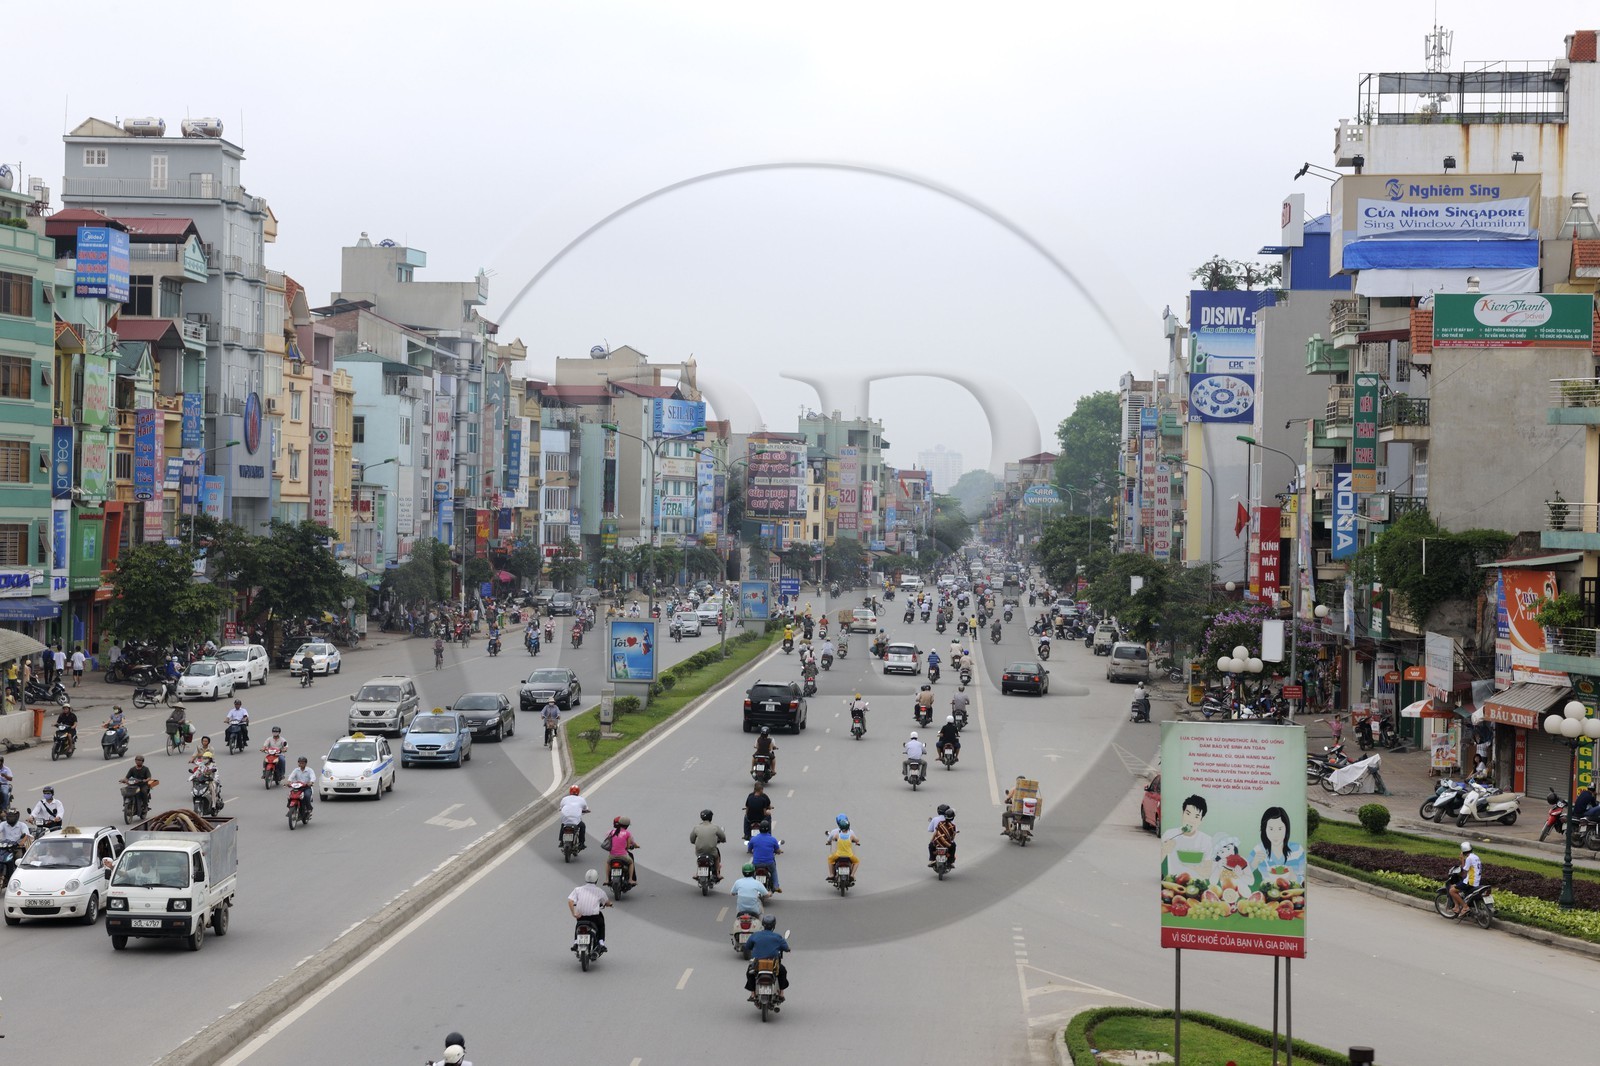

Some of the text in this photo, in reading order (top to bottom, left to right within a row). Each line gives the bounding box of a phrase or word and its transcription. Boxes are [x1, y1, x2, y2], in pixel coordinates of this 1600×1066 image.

[1410, 185, 1500, 199] Nghiêm Sing
[1364, 220, 1394, 230] Sing
[1400, 220, 1455, 228] Window
[438, 412, 449, 423] NHA
[668, 405, 695, 421] SEILAR
[137, 425, 155, 437] Hair
[436, 430, 450, 441] KHOA
[438, 467, 446, 479] AN
[840, 489, 856, 503] 520
[666, 503, 682, 516] ERA
[1337, 472, 1353, 550] NOKIA
[1261, 540, 1279, 551] KÍNH
[1265, 571, 1275, 581] HÀ
[613, 638, 628, 647] Tôi
[1511, 713, 1533, 725] XINH
[1172, 933, 1179, 941] VÌ
[1181, 933, 1196, 943] SỨC
[1220, 935, 1235, 945] CỦA
[1236, 938, 1252, 949] BẠN
[1253, 938, 1264, 948] VÀ
[1265, 940, 1278, 949] GIA
[1280, 941, 1298, 950] ĐÌNH
